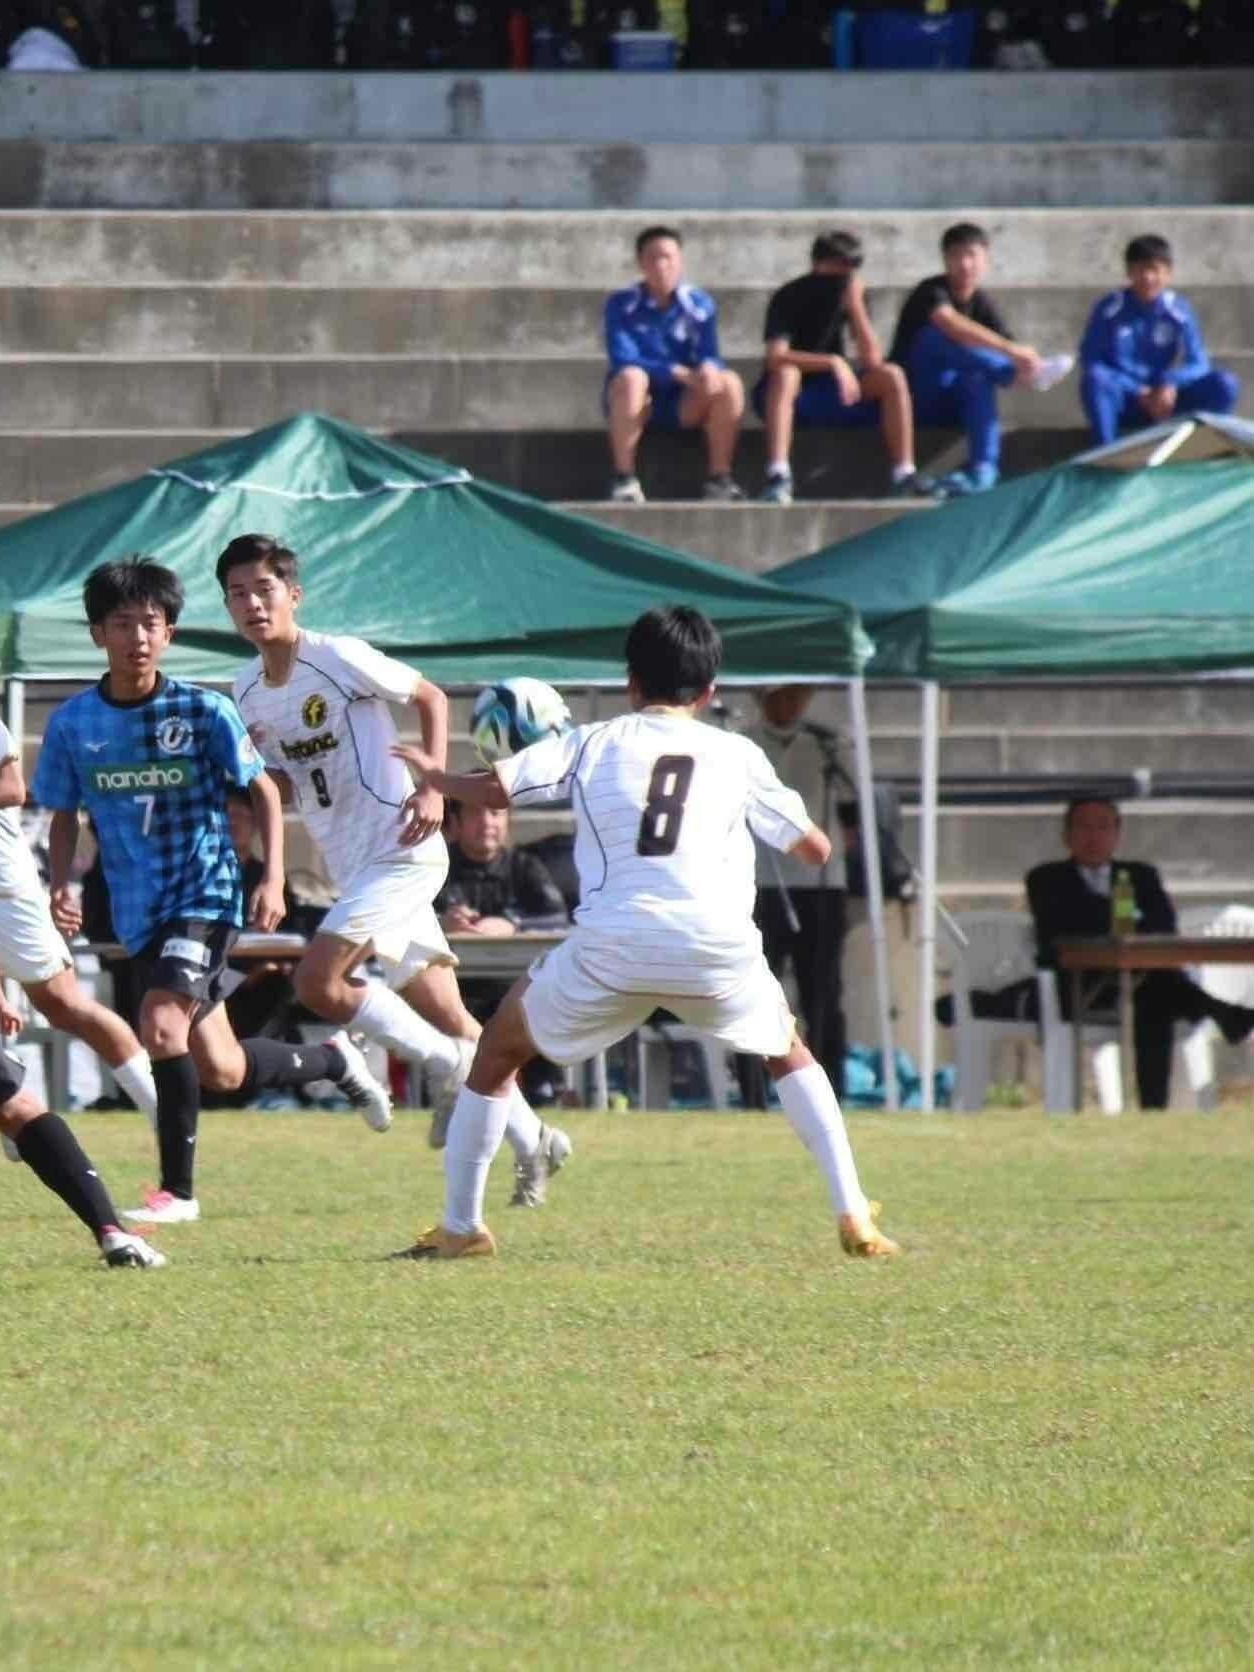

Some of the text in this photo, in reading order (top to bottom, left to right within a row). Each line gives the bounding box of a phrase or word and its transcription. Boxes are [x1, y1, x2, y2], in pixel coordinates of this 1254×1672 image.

[96, 764, 184, 790] nanaho
[310, 768, 333, 808] 9
[133, 794, 155, 837] 7
[636, 754, 696, 857] 8
